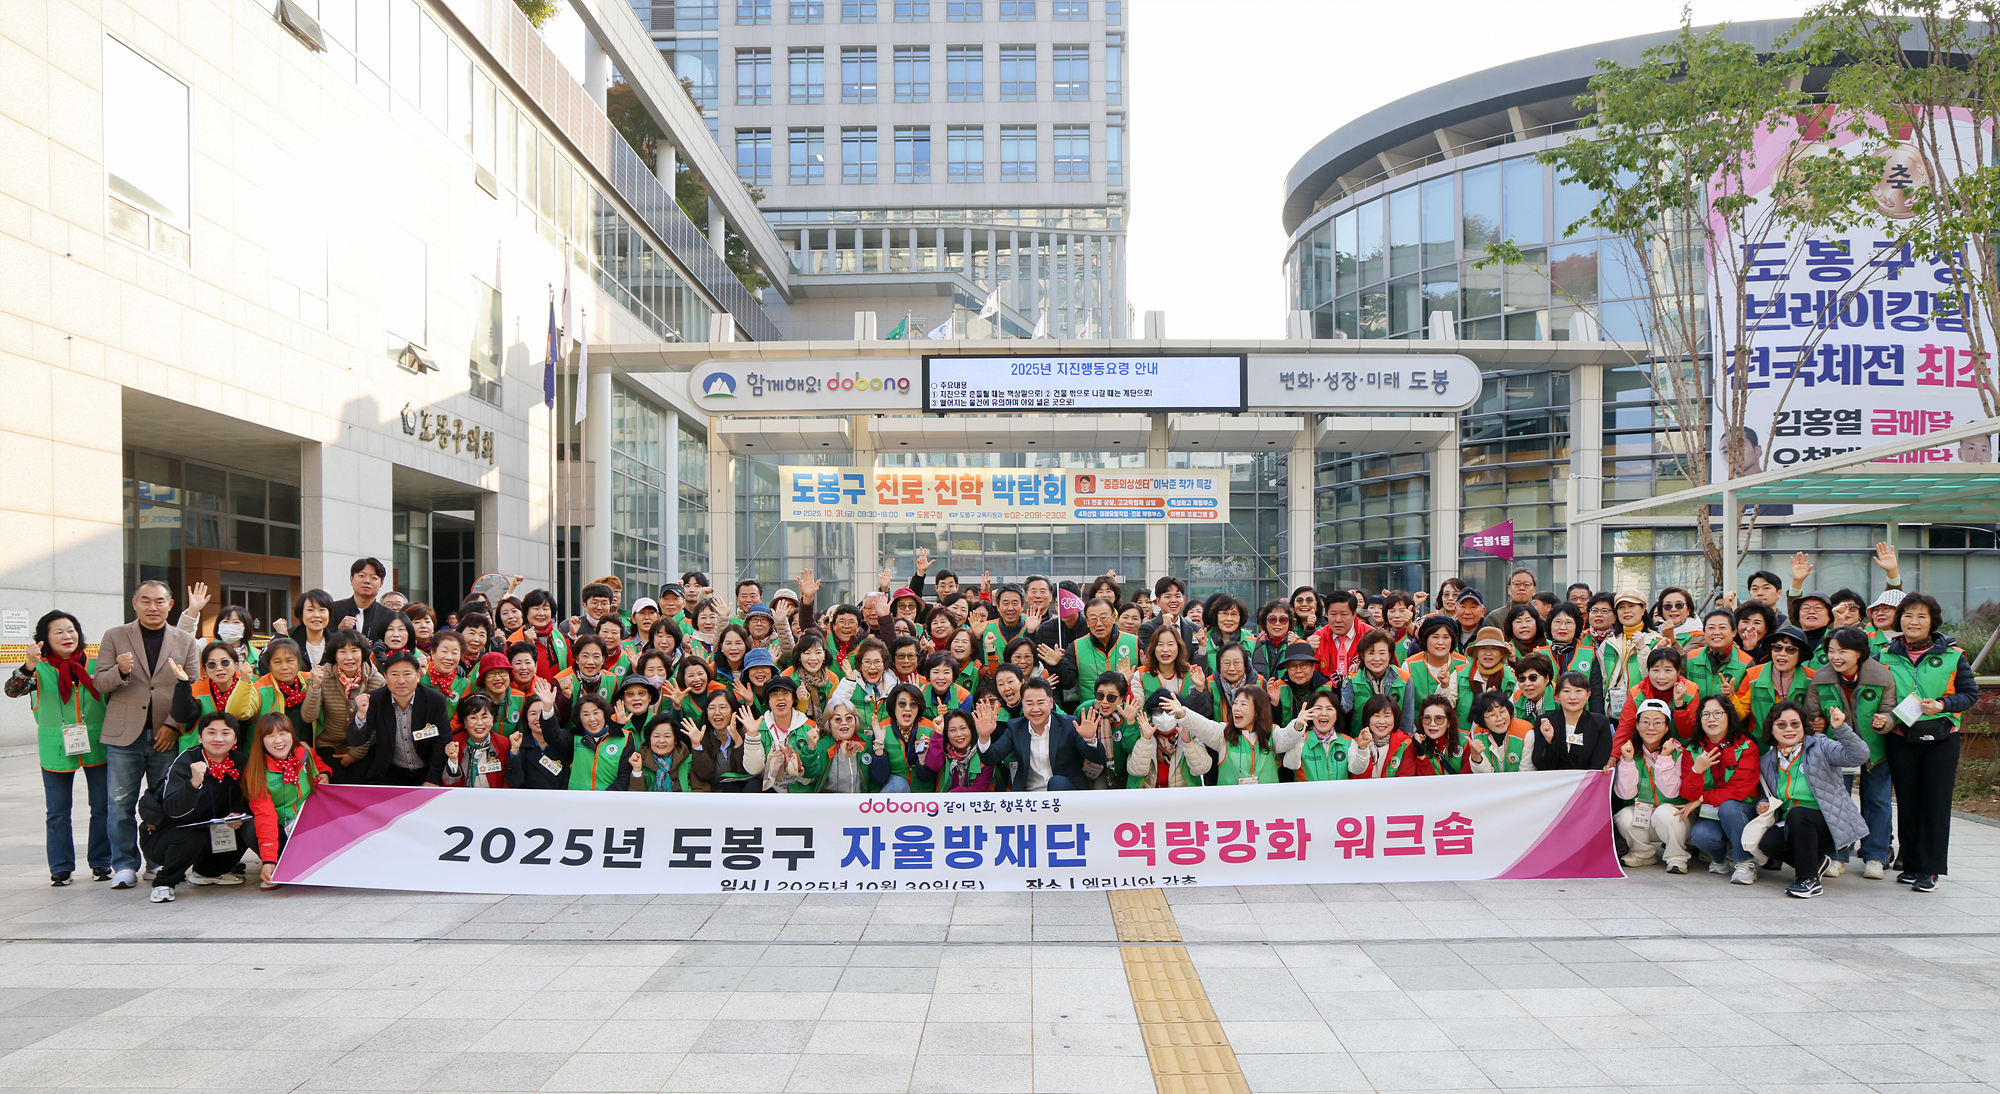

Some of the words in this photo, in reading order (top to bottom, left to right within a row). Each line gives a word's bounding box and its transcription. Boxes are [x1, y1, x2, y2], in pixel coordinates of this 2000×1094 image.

[1887, 164, 1913, 189] 축
[1011, 362, 1052, 376] 2025년
[1057, 362, 1129, 376] 지진행동요령
[1135, 362, 1158, 376] 안내
[1727, 344, 1904, 389] 전국체전
[747, 371, 821, 397] 함께해요!
[827, 371, 910, 394] dobong
[940, 381, 967, 389] 주요내용
[1409, 369, 1449, 395] 도봉
[940, 390, 967, 398] 지진으로
[1053, 390, 1067, 398] 건물
[1069, 390, 1090, 398] 밖으로
[991, 398, 1019, 406] 유의하며
[1773, 408, 1862, 437] 김홍열
[1871, 409, 1954, 436] 금메달
[792, 473, 866, 505] 도봉구
[992, 473, 1067, 506] 박람회
[1179, 478, 1194, 490] 작가
[1196, 478, 1212, 490] 특강
[917, 511, 943, 519] 도봉구청
[1010, 511, 1067, 519] 02-2091-2302
[1473, 535, 1511, 547] 도봉1동
[859, 798, 939, 818] dobong
[943, 800, 966, 814] 같이
[999, 798, 1038, 813] 행복한
[1041, 798, 1061, 813] 도봉
[438, 825, 646, 871] 2025년
[668, 826, 816, 873] 도봉구
[840, 821, 1090, 872] 자율방재단
[1112, 817, 1312, 867] 역량강화
[1333, 810, 1475, 860] 워크숍
